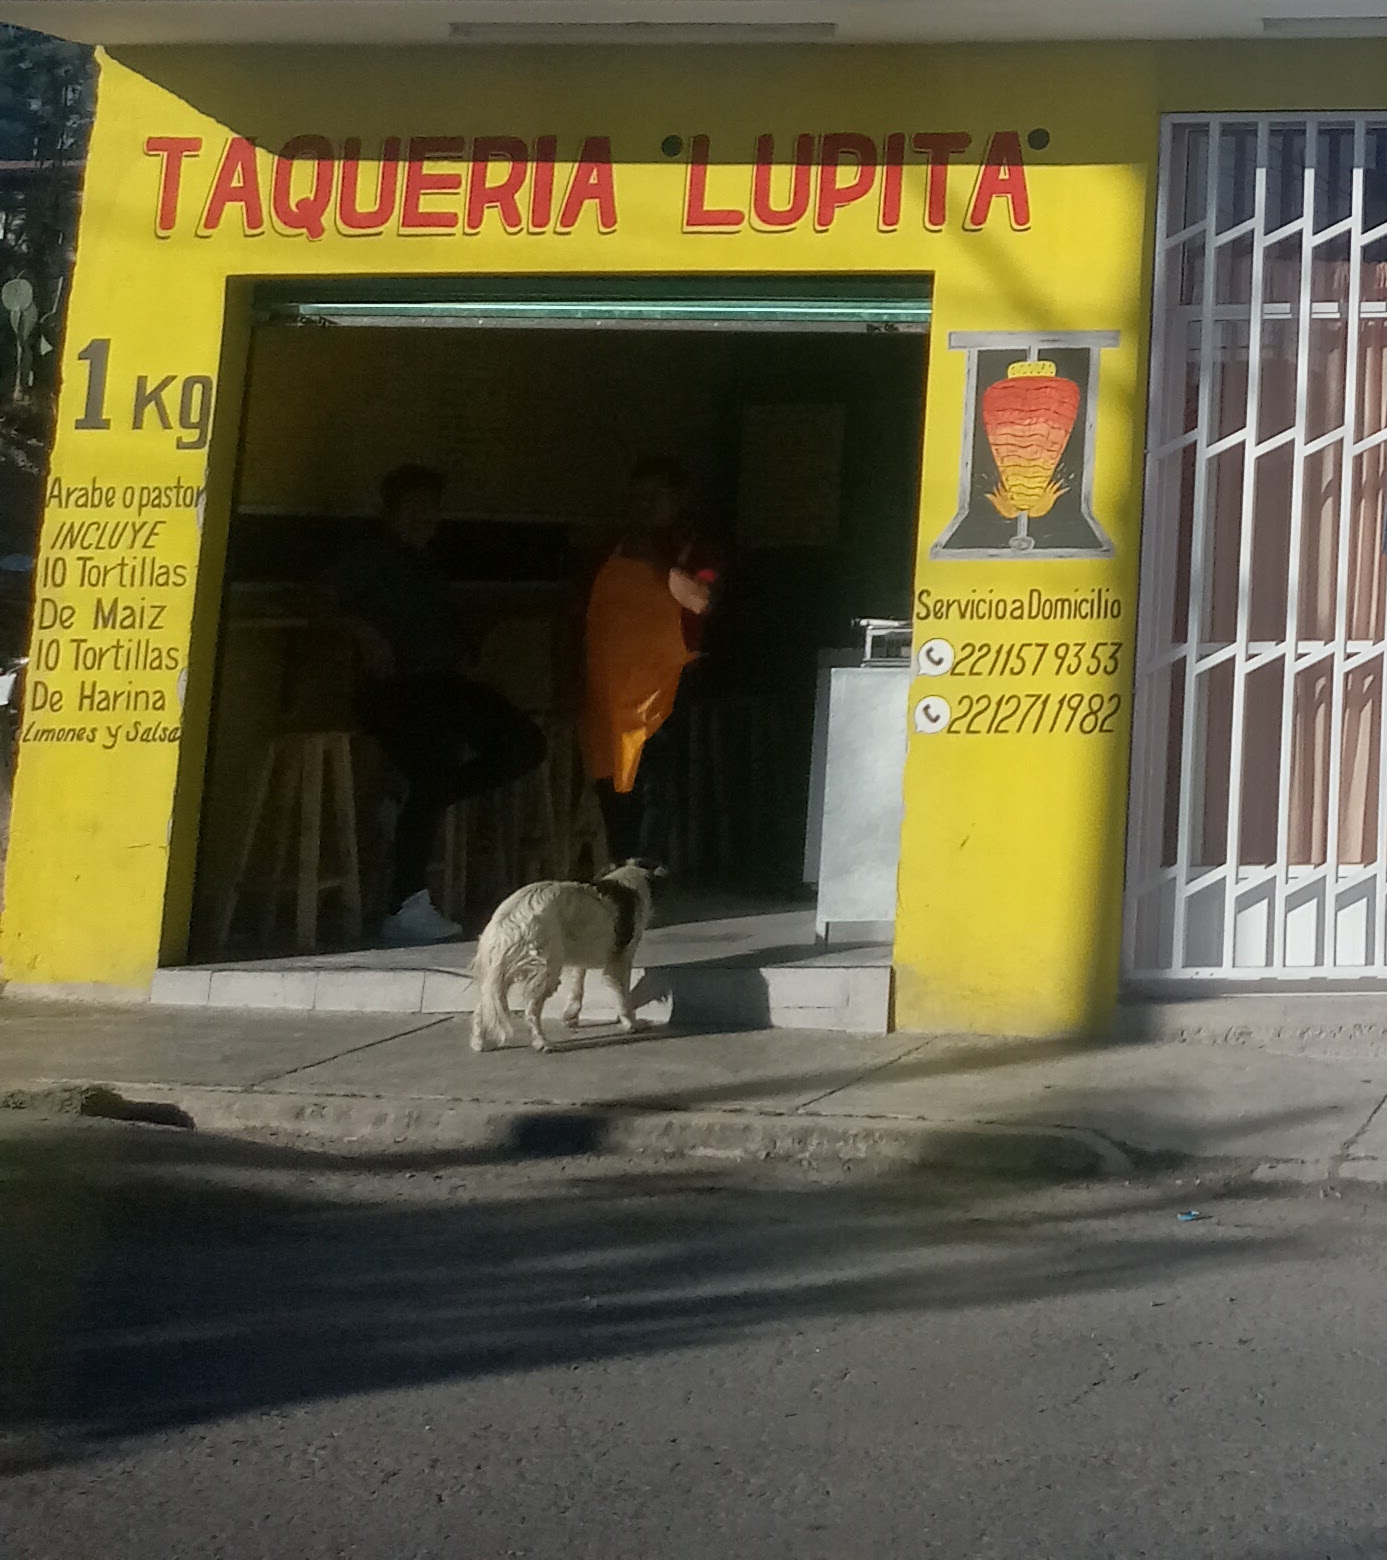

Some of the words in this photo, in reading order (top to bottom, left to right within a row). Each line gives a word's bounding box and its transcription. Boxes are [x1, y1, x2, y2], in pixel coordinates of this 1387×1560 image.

[144, 134, 619, 241] TAQUERIA
[682, 130, 1032, 234] LUPITA
[74, 338, 111, 430] 1
[131, 374, 214, 451] Kg
[46, 476, 116, 510] Arabe
[49, 520, 167, 551] INCLUYE
[42, 556, 68, 589] 10
[76, 555, 188, 589] Tortillas
[38, 597, 76, 631] De
[92, 596, 168, 631] Maiz
[916, 588, 1007, 621] Servicio
[1009, 598, 1025, 621] a
[1028, 587, 1122, 621] Domicilio
[35, 638, 61, 672] 10
[70, 638, 180, 672] Tortillas
[31, 680, 64, 713] De
[78, 680, 166, 713] Harina
[22, 721, 98, 744] Limones
[101, 723, 123, 750] y
